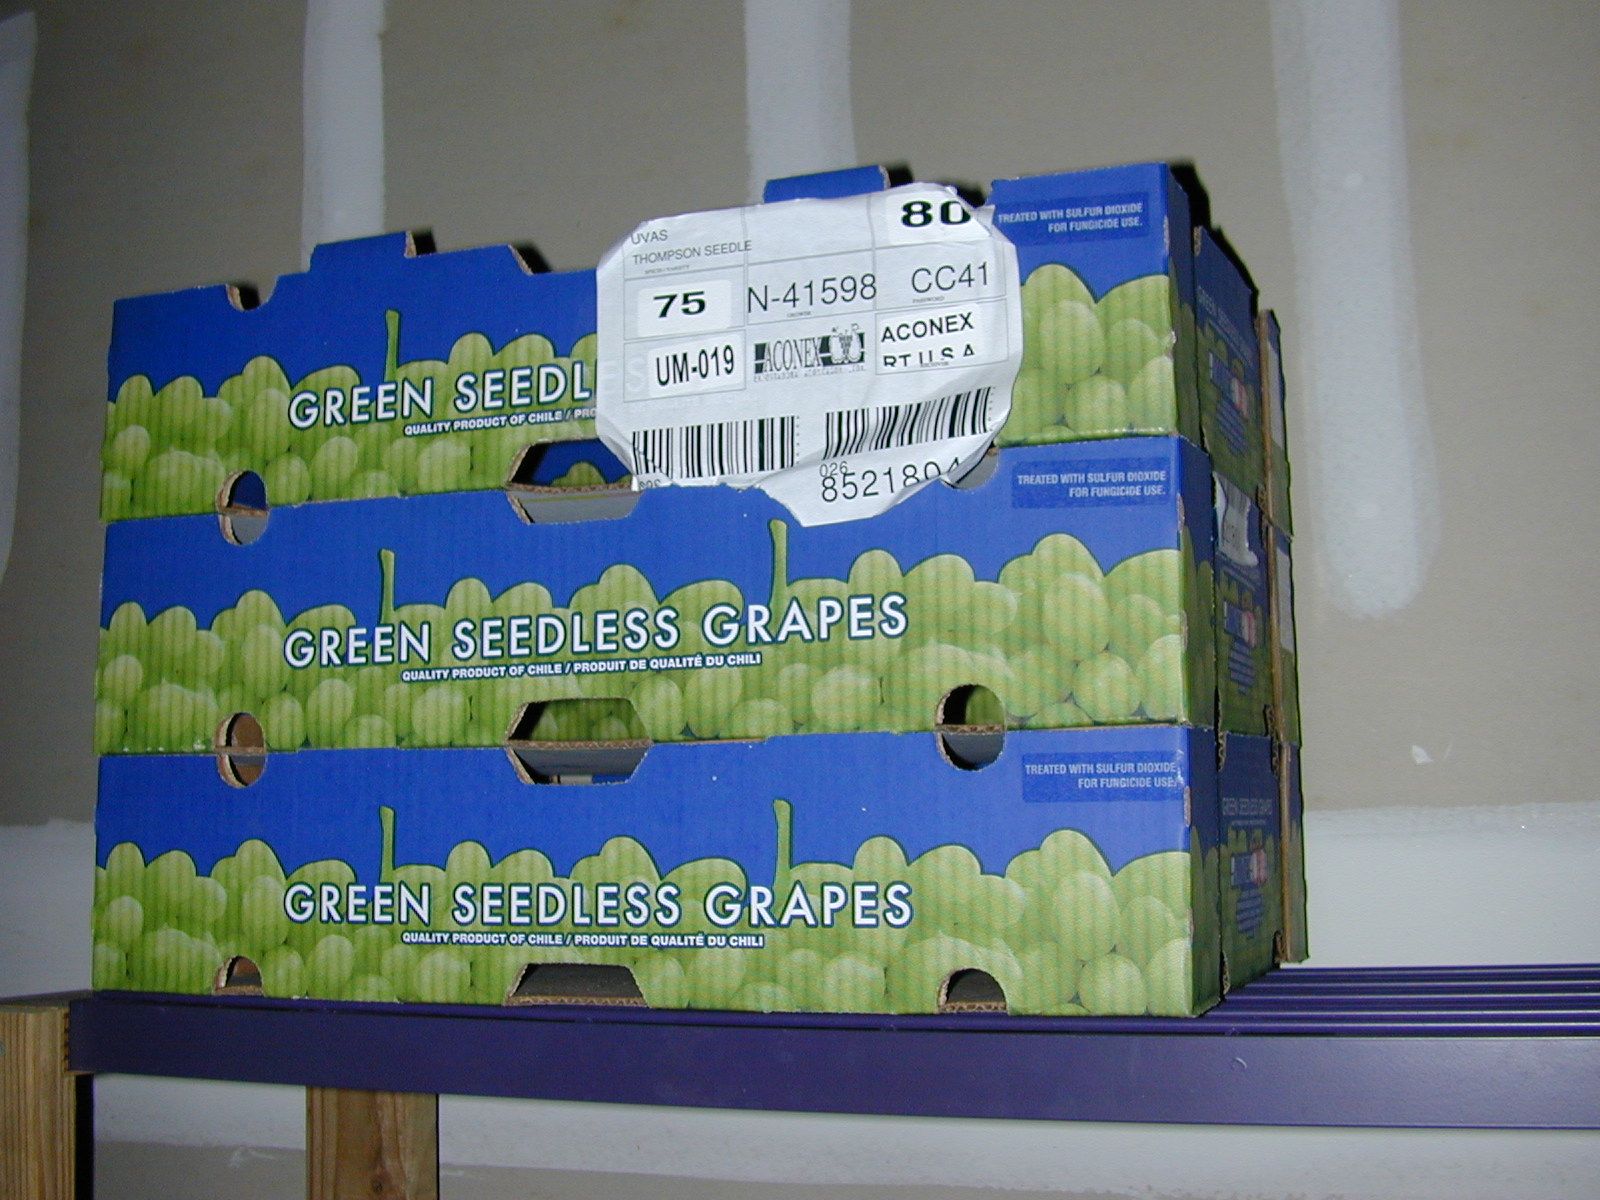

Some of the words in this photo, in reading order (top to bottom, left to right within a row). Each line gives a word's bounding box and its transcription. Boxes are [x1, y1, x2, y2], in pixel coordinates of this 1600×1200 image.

[901, 200, 971, 228] 80
[998, 211, 1038, 224] TREATED
[1040, 208, 1064, 220] WITH
[1065, 206, 1103, 219] SULFUR
[1104, 202, 1143, 215] DIOXIDE
[1048, 222, 1067, 233] FOR
[1070, 218, 1119, 231] FUNGICIDE
[631, 229, 668, 245] UVAS
[633, 246, 701, 265] THOMPSON
[704, 240, 752, 256] SEEDLE
[911, 261, 988, 293] CC41
[653, 291, 706, 318] 75
[747, 273, 877, 314] N-41598
[881, 311, 974, 343] ACONEX
[656, 344, 735, 386] UM-019
[763, 337, 823, 372] ACONEX
[883, 353, 912, 368] RT
[289, 379, 433, 428] GREEN
[455, 363, 592, 412] SEEDL
[405, 421, 451, 436] QUALITY
[453, 417, 507, 431] PRODUCT
[509, 414, 526, 425] OF
[528, 411, 562, 422] CHILE
[820, 461, 848, 478] 026
[1018, 474, 1059, 485] TREATED
[1060, 473, 1085, 484] WITH
[1087, 472, 1125, 483] SULFUR
[1127, 470, 1166, 482] DIOXIDE
[1069, 487, 1089, 498] FOR
[1091, 485, 1141, 497] FUNGICIDE
[284, 624, 430, 668] GREEN
[453, 609, 679, 660] SEEDLESS
[703, 595, 907, 645] GRAPES
[403, 668, 449, 682] QUALITY
[452, 666, 507, 679] PRODUCT
[510, 666, 525, 677] OF
[528, 664, 562, 676] CHILE
[574, 660, 626, 674] PRODUIT
[629, 660, 647, 670] DE
[650, 654, 702, 670] QUALITÉ
[706, 655, 723, 667] DU
[727, 653, 761, 665] CHILI
[1025, 764, 1067, 775] TREATED
[1068, 763, 1094, 774] WITH
[1096, 763, 1135, 774] SULFUR
[1137, 762, 1176, 773] DIOXIDE
[1078, 778, 1098, 789] FOR
[1100, 777, 1151, 788] FUNGICIDE
[284, 882, 430, 925] GREEN
[453, 884, 681, 927] SEEDLESS
[705, 883, 912, 927] GRAPES
[403, 932, 449, 944] QUALITY
[452, 932, 507, 944] PRODUCT
[510, 934, 525, 944] OF
[528, 934, 562, 945] CHILE
[575, 935, 627, 946] PRODUIT
[631, 935, 648, 946] DE
[651, 931, 704, 948] QUALITÉ
[707, 936, 725, 947] DU
[729, 936, 763, 947] CHILI
